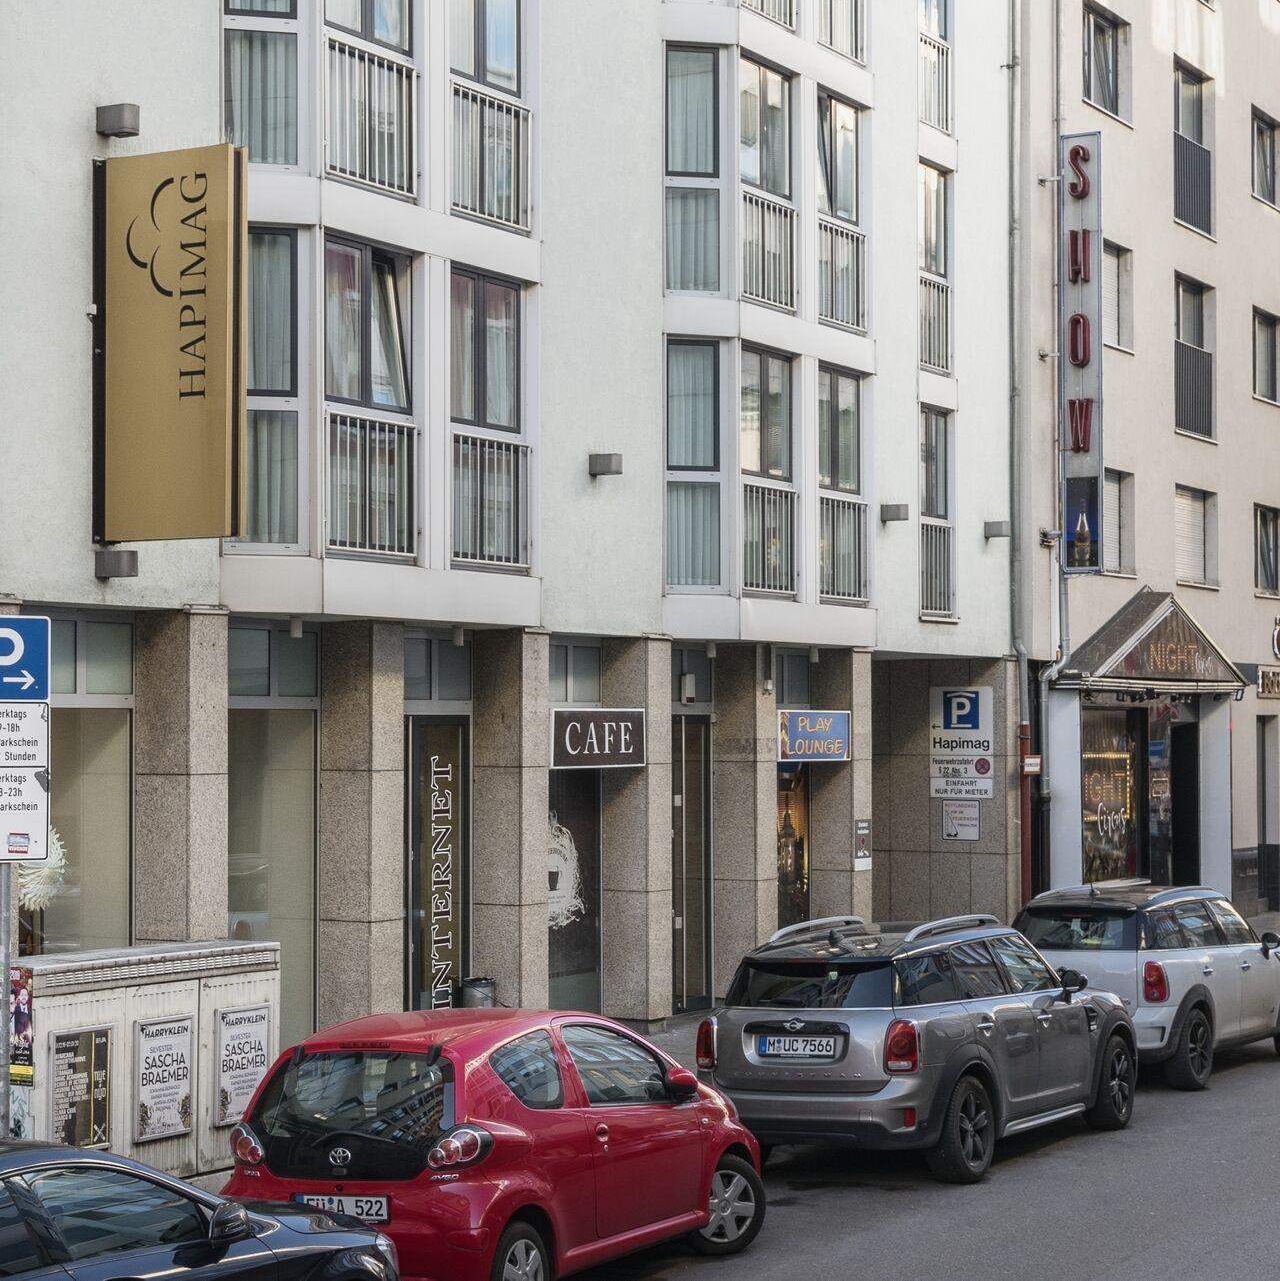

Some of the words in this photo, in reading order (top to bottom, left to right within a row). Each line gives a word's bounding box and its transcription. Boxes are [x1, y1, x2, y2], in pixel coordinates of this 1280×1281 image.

[178, 170, 208, 402] HAPIMAG
[1067, 144, 1094, 453] SHOW
[1149, 642, 1197, 670] NIGHT
[951, 697, 971, 725] P
[798, 716, 833, 733] PLAY
[565, 721, 634, 755] CAFE
[786, 738, 843, 755] LOUNGE
[932, 737, 990, 752] Hapimag
[4, 752, 37, 761] Stunden
[430, 755, 452, 1011] INTERNET
[225, 1013, 266, 1027] HARRYKLEIN
[144, 1024, 189, 1039] HARRYKLEIN
[149, 1044, 173, 1054] SILVESTER
[224, 1039, 264, 1058] SASCHA
[783, 1039, 799, 1053] UC
[802, 1039, 833, 1053] 7566
[144, 1051, 186, 1071] SASCHA
[222, 1053, 266, 1073] BRAEMER
[141, 1066, 189, 1087] BRAEMER
[355, 1199, 384, 1218] 522
